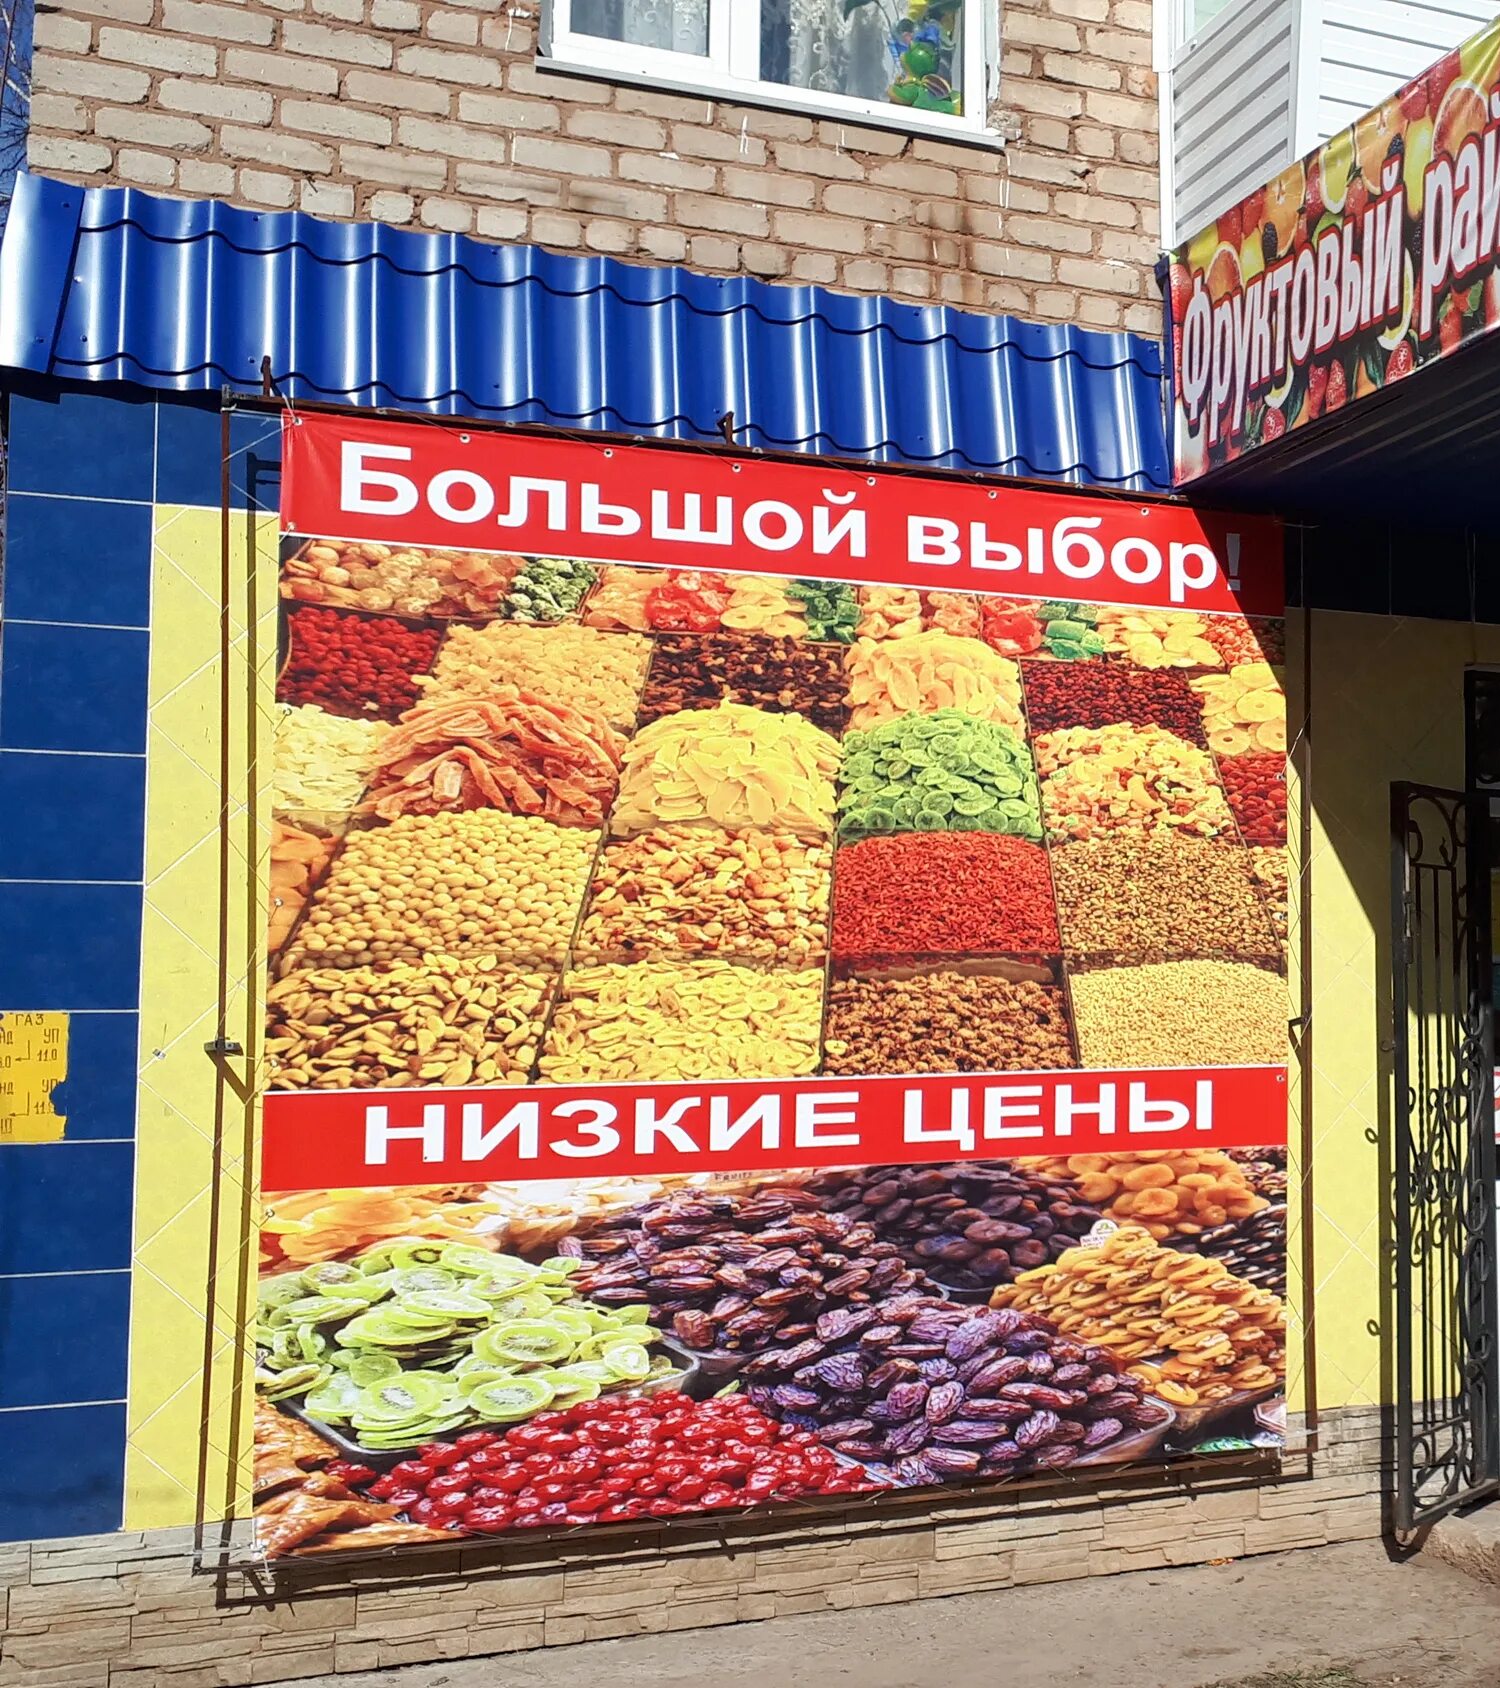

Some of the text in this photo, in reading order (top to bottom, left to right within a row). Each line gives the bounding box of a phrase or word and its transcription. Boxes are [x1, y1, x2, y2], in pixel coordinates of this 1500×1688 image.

[1182, 154, 1406, 446] Фруктовый
[341, 441, 1241, 603] Большой выбор!
[16, 1013, 44, 1026] ГАЗ
[43, 1028, 60, 1044] УП
[364, 1080, 1213, 1165] НИЗКИЕ ЦЕНЫ
